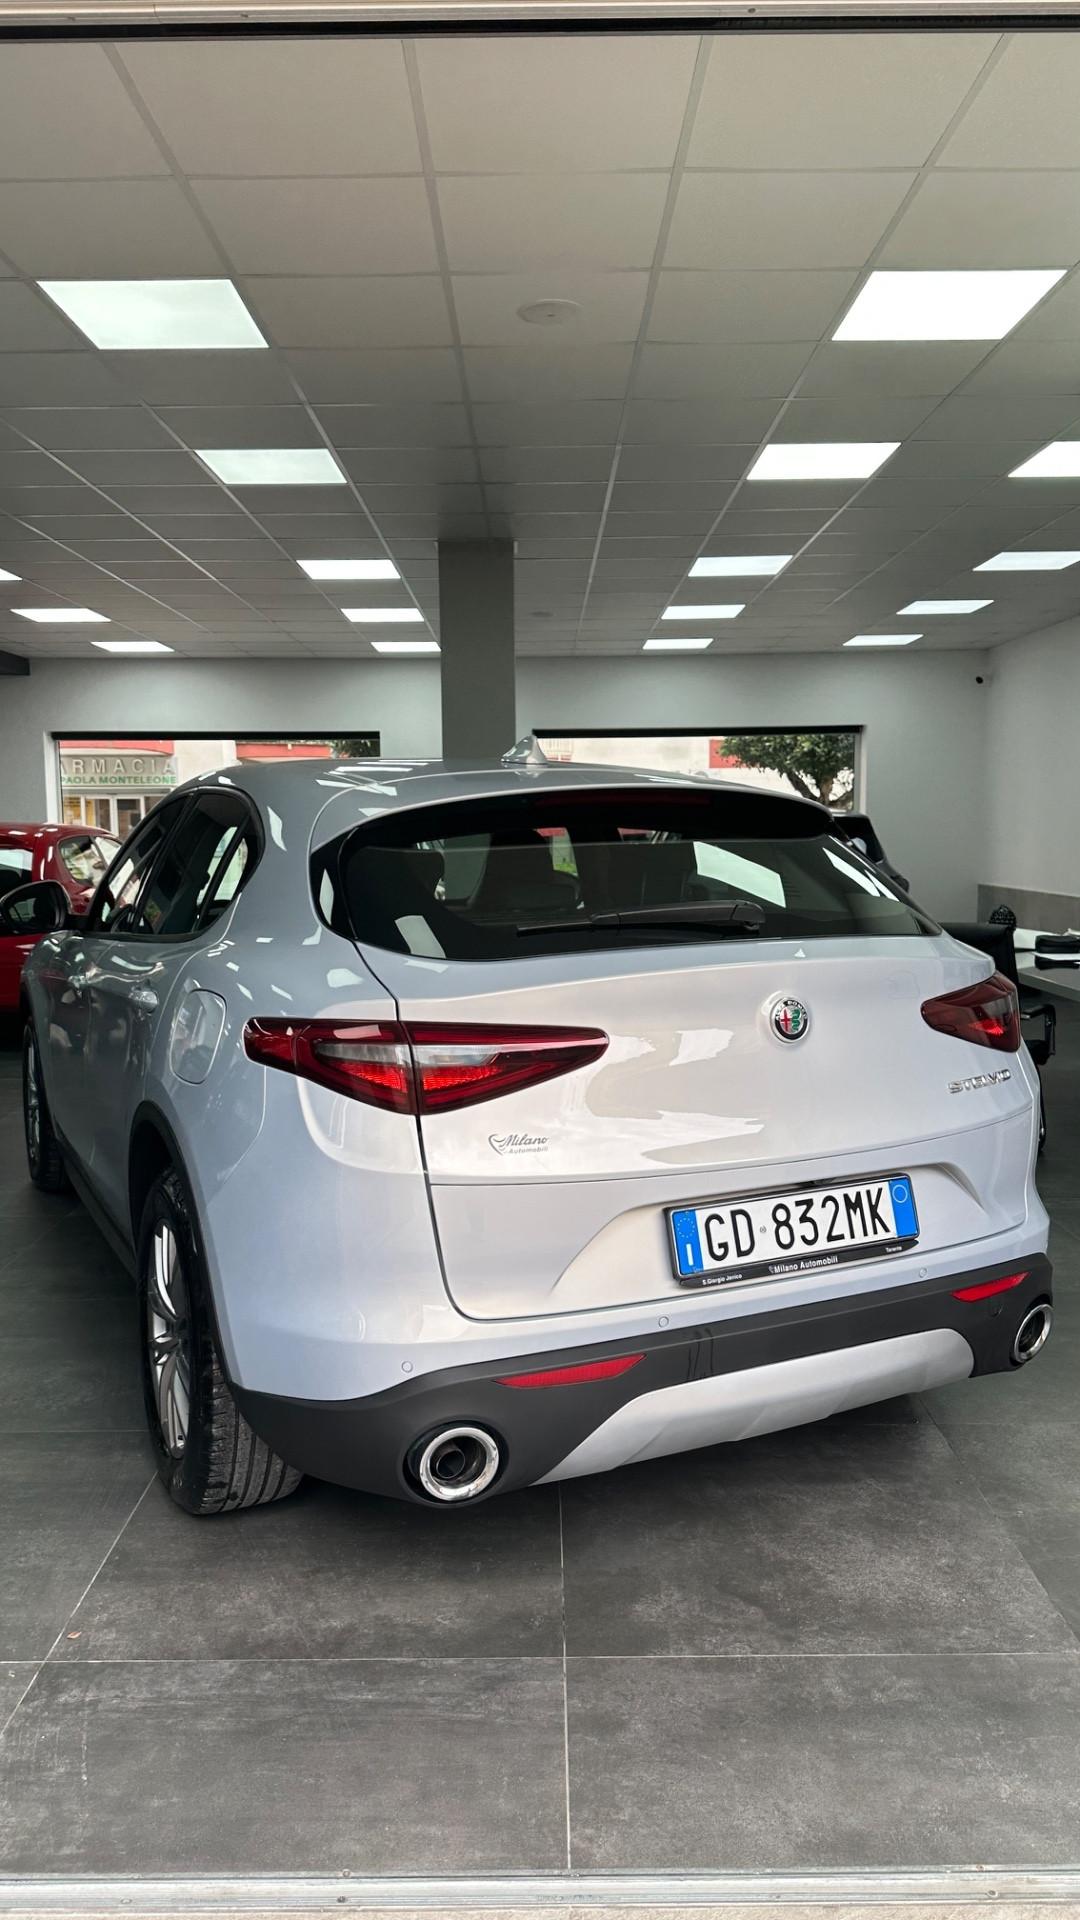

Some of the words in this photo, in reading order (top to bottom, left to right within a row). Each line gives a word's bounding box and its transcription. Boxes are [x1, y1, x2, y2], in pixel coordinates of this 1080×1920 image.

[99, 776, 176, 784] MONTELEONE
[947, 1068, 1011, 1093] STELVIO
[500, 1133, 549, 1147] Milano
[704, 1208, 756, 1262] GD
[771, 1187, 891, 1251] 832MK
[774, 1263, 798, 1273] Milano
[800, 1255, 839, 1269] Automobili
